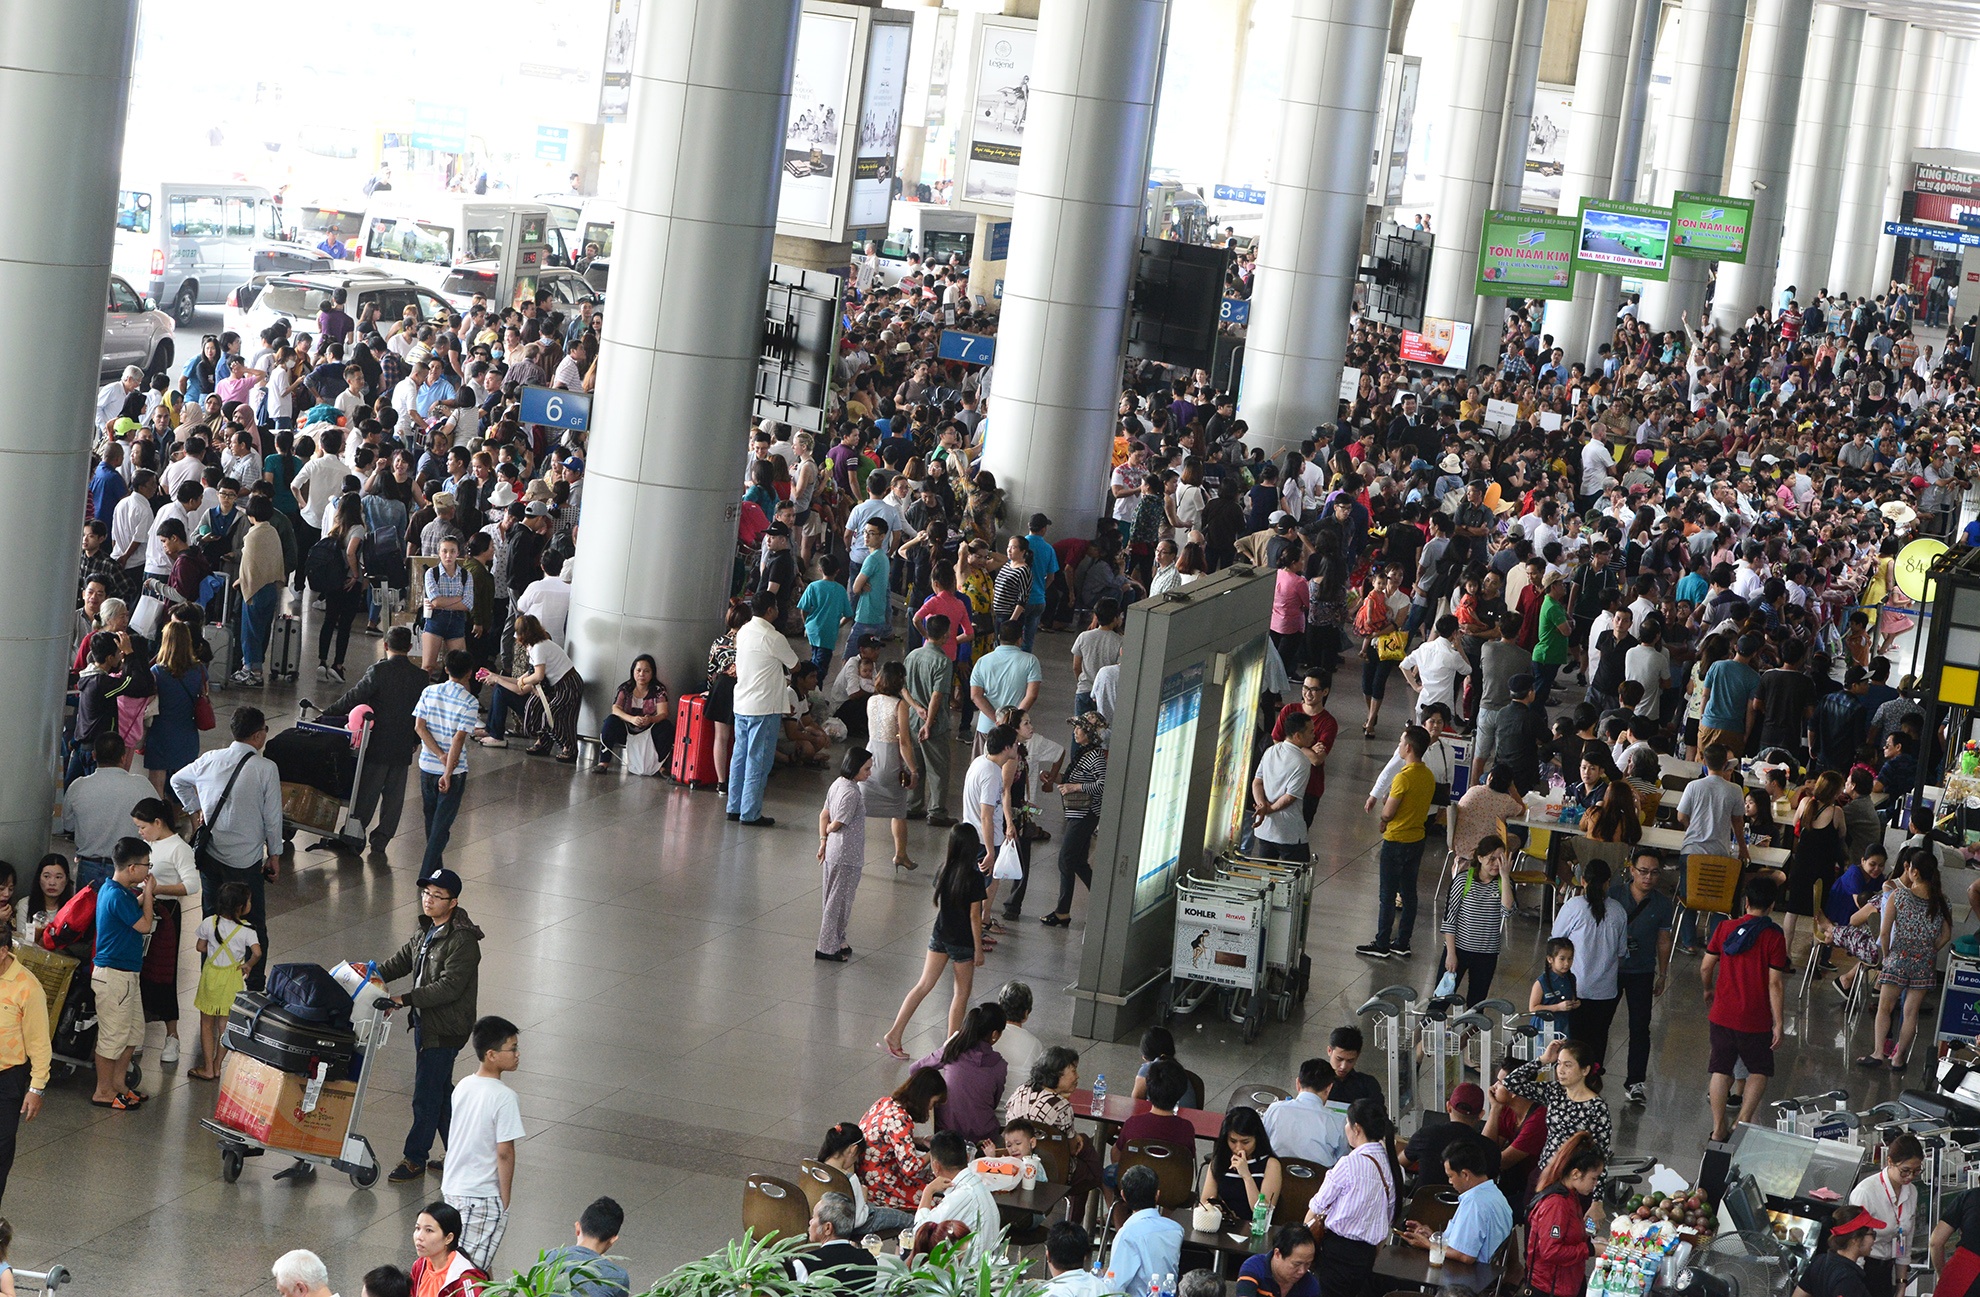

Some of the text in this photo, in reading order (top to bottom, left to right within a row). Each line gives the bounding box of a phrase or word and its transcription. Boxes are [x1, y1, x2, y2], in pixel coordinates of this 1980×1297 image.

[1919, 168, 1974, 184] KING DEALS
[1677, 217, 1744, 234] TÔN NAM KIM
[1489, 244, 1569, 262] TÔN NAM KIM
[1220, 302, 1231, 318] 8
[960, 337, 975, 357] 7
[546, 396, 563, 422] 6
[571, 417, 583, 425] GF
[1184, 908, 1216, 919] KOHLER
